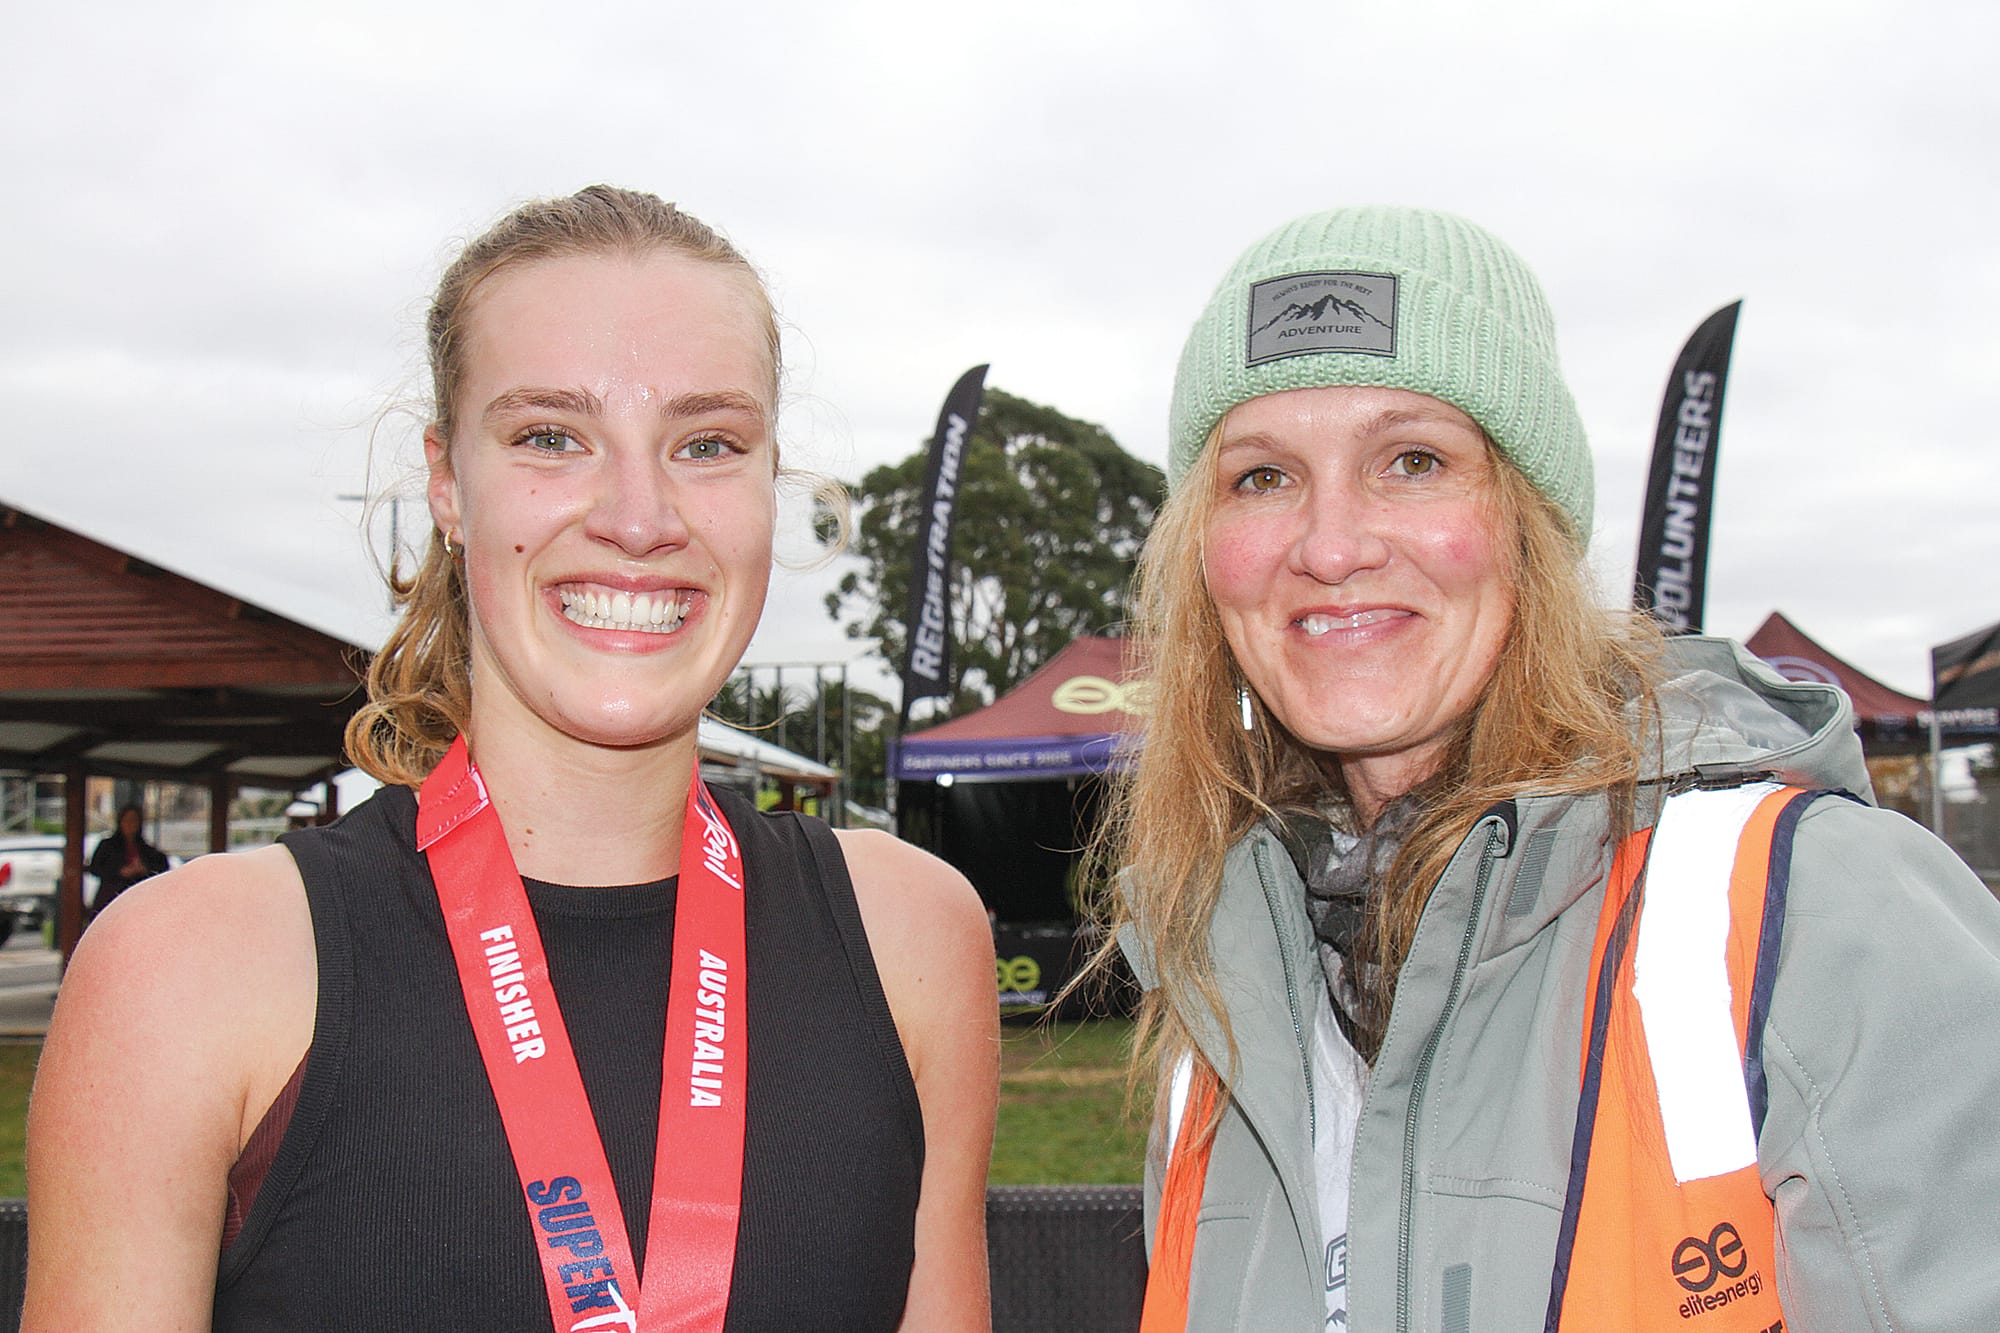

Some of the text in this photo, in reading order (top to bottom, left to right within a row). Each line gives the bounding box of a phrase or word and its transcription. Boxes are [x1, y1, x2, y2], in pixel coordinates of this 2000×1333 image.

[1278, 325, 1363, 339] ADVENTURE
[1324, 279, 1338, 287] FOR
[480, 924, 546, 1065] FINISHER
[690, 948, 728, 1108] AUSTRALIA
[527, 1176, 623, 1314] SUPER
